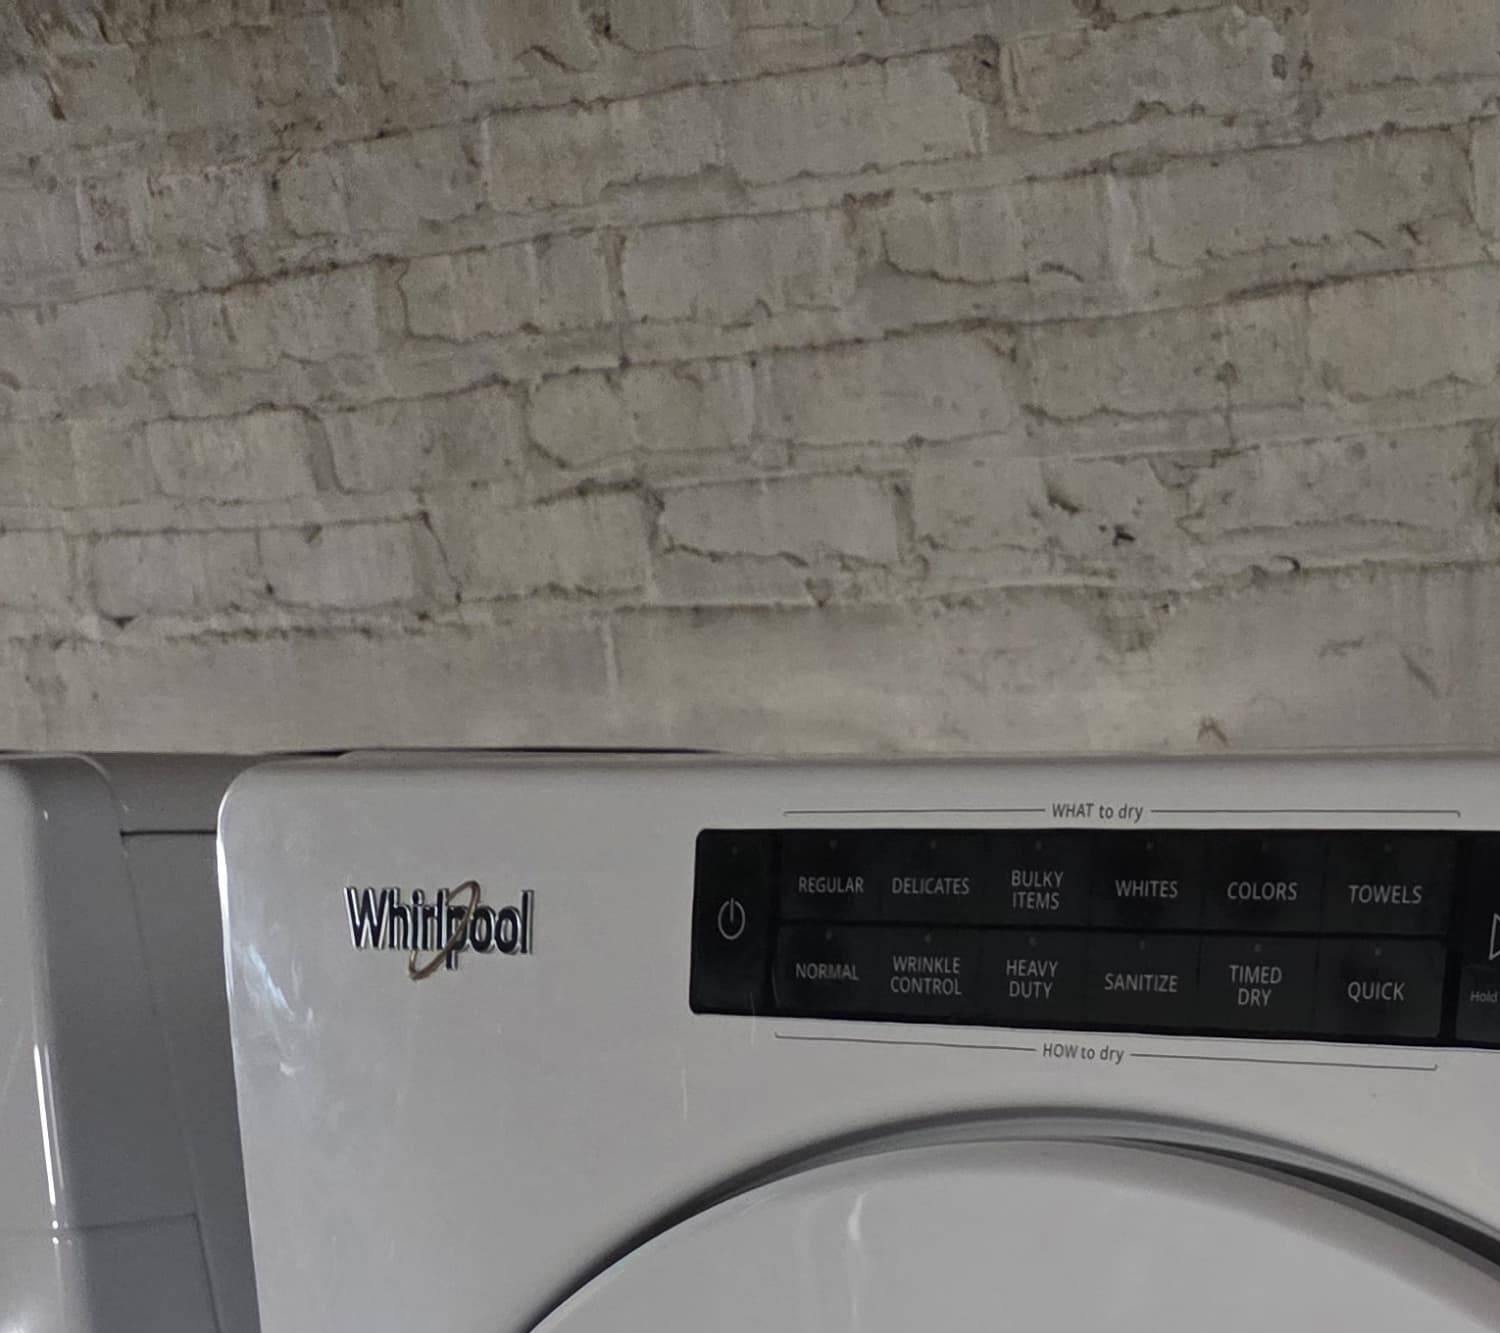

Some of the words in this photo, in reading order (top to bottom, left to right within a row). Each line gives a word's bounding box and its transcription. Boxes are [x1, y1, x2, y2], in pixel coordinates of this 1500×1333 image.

[1051, 803, 1094, 819] WHAT
[1099, 804, 1114, 819] to
[1118, 804, 1143, 823] dry
[799, 876, 864, 894] REGULAR
[891, 877, 970, 895] DELICATES
[1011, 870, 1064, 887] BULKY
[1115, 880, 1178, 898] WHITES
[1227, 881, 1298, 901] COLORS
[1348, 884, 1423, 905] TOWELS
[1012, 892, 1059, 910] ITEMS
[344, 886, 534, 970] Whirlpool
[795, 962, 859, 981] NORMAL
[892, 956, 961, 974] WRINKLE
[1005, 960, 1058, 978] HEAVY
[1104, 974, 1178, 993] SANITIZE
[1229, 965, 1282, 985] TIMED
[890, 976, 962, 996] CONTROL
[1008, 981, 1053, 999] DUTY
[1347, 981, 1405, 1003] QUICK
[1238, 988, 1272, 1008] DRY
[1042, 1043, 1077, 1059] HOW
[1080, 1045, 1095, 1060] to
[1099, 1045, 1124, 1064] dry
